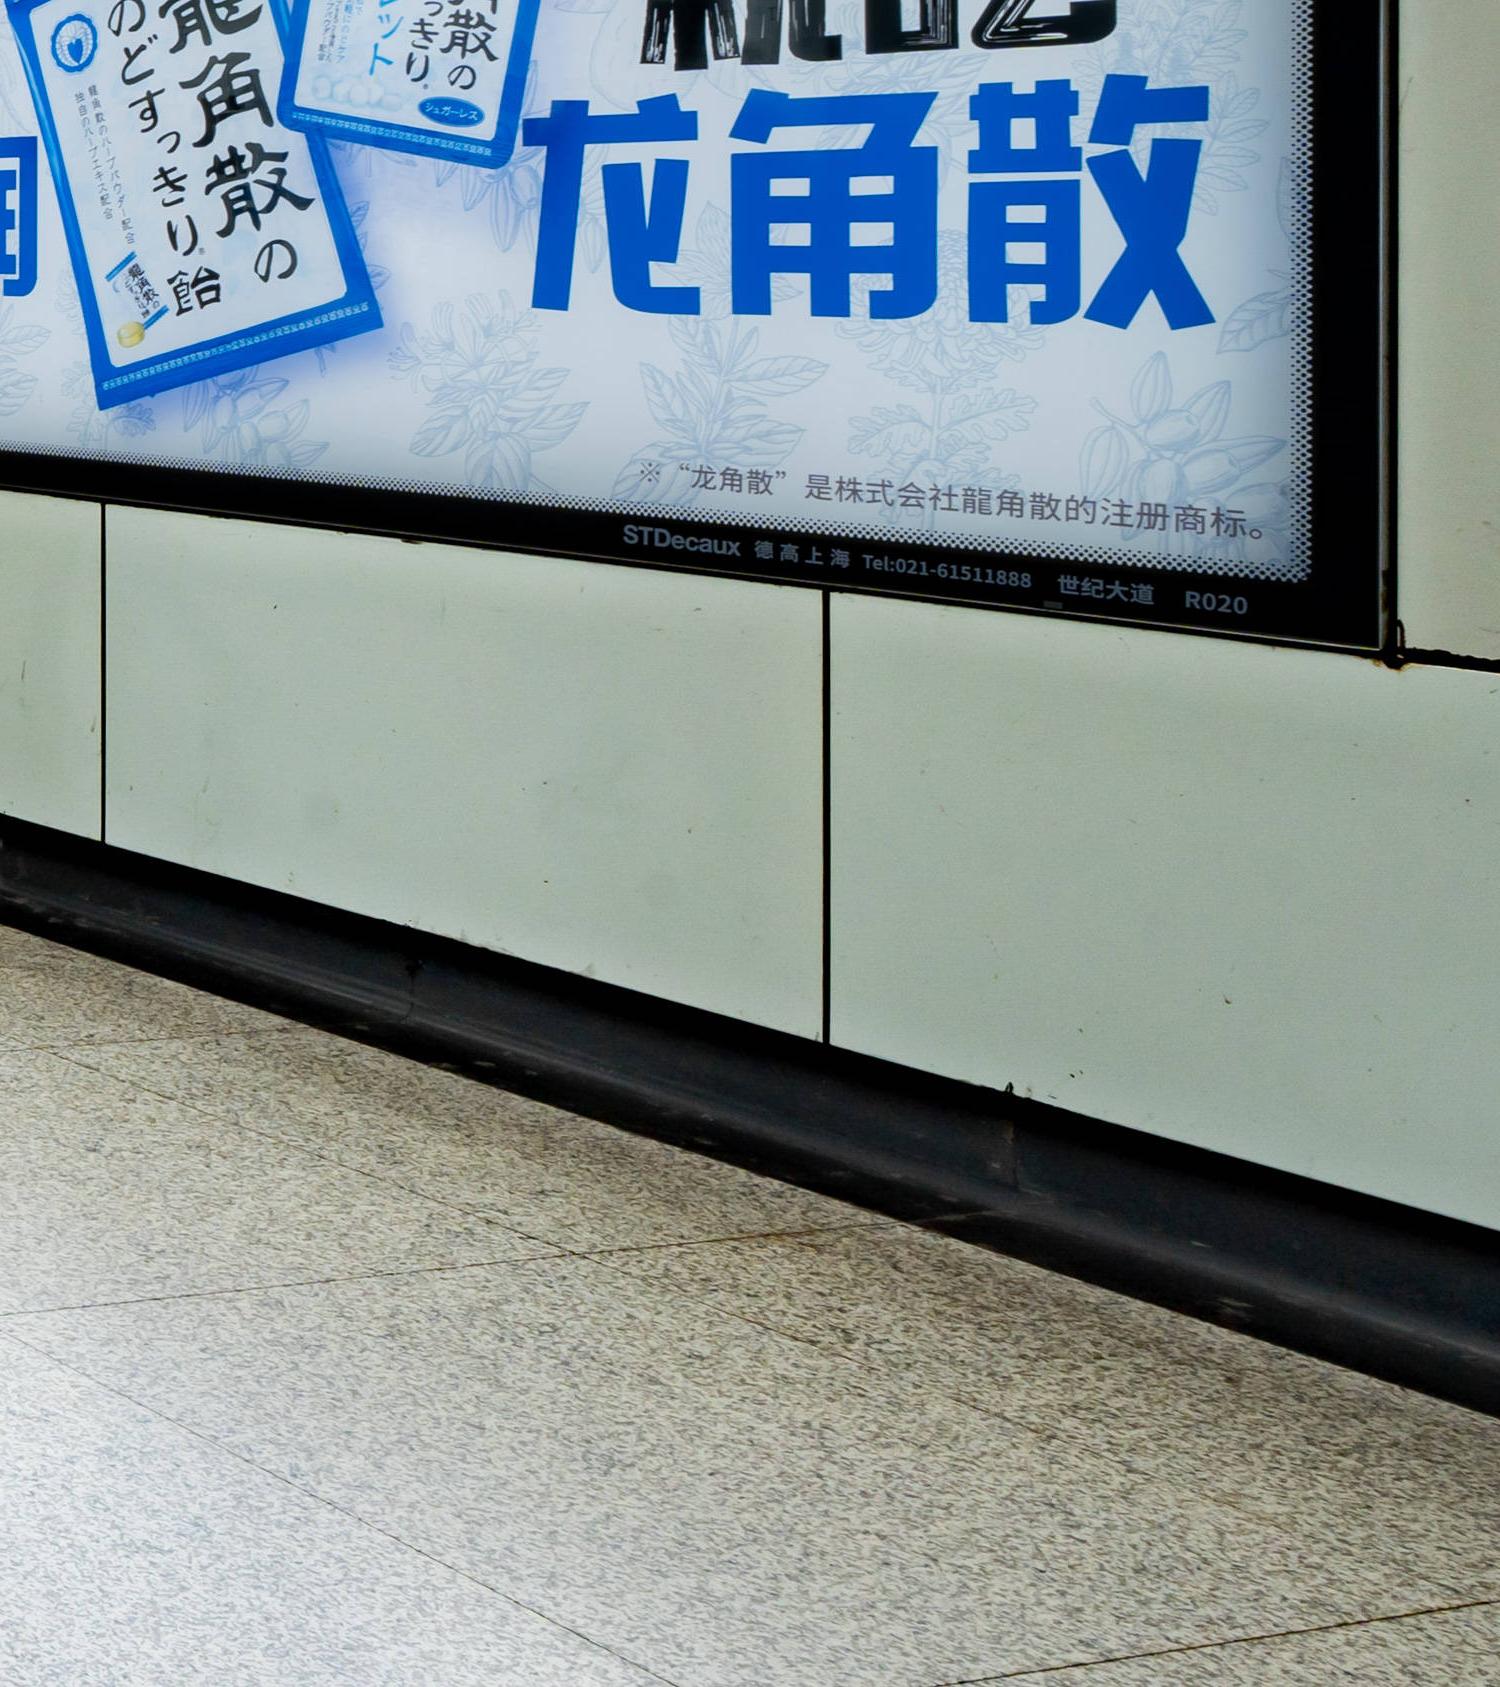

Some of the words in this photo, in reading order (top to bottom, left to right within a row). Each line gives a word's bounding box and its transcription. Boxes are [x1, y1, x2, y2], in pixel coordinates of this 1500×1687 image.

[424, 101, 479, 121] シュガーレス
[522, 74, 1216, 332] 龙角散
[623, 524, 741, 558] STDecaux
[1057, 574, 1155, 605] 世纪大道
[1185, 590, 1248, 615] R020
